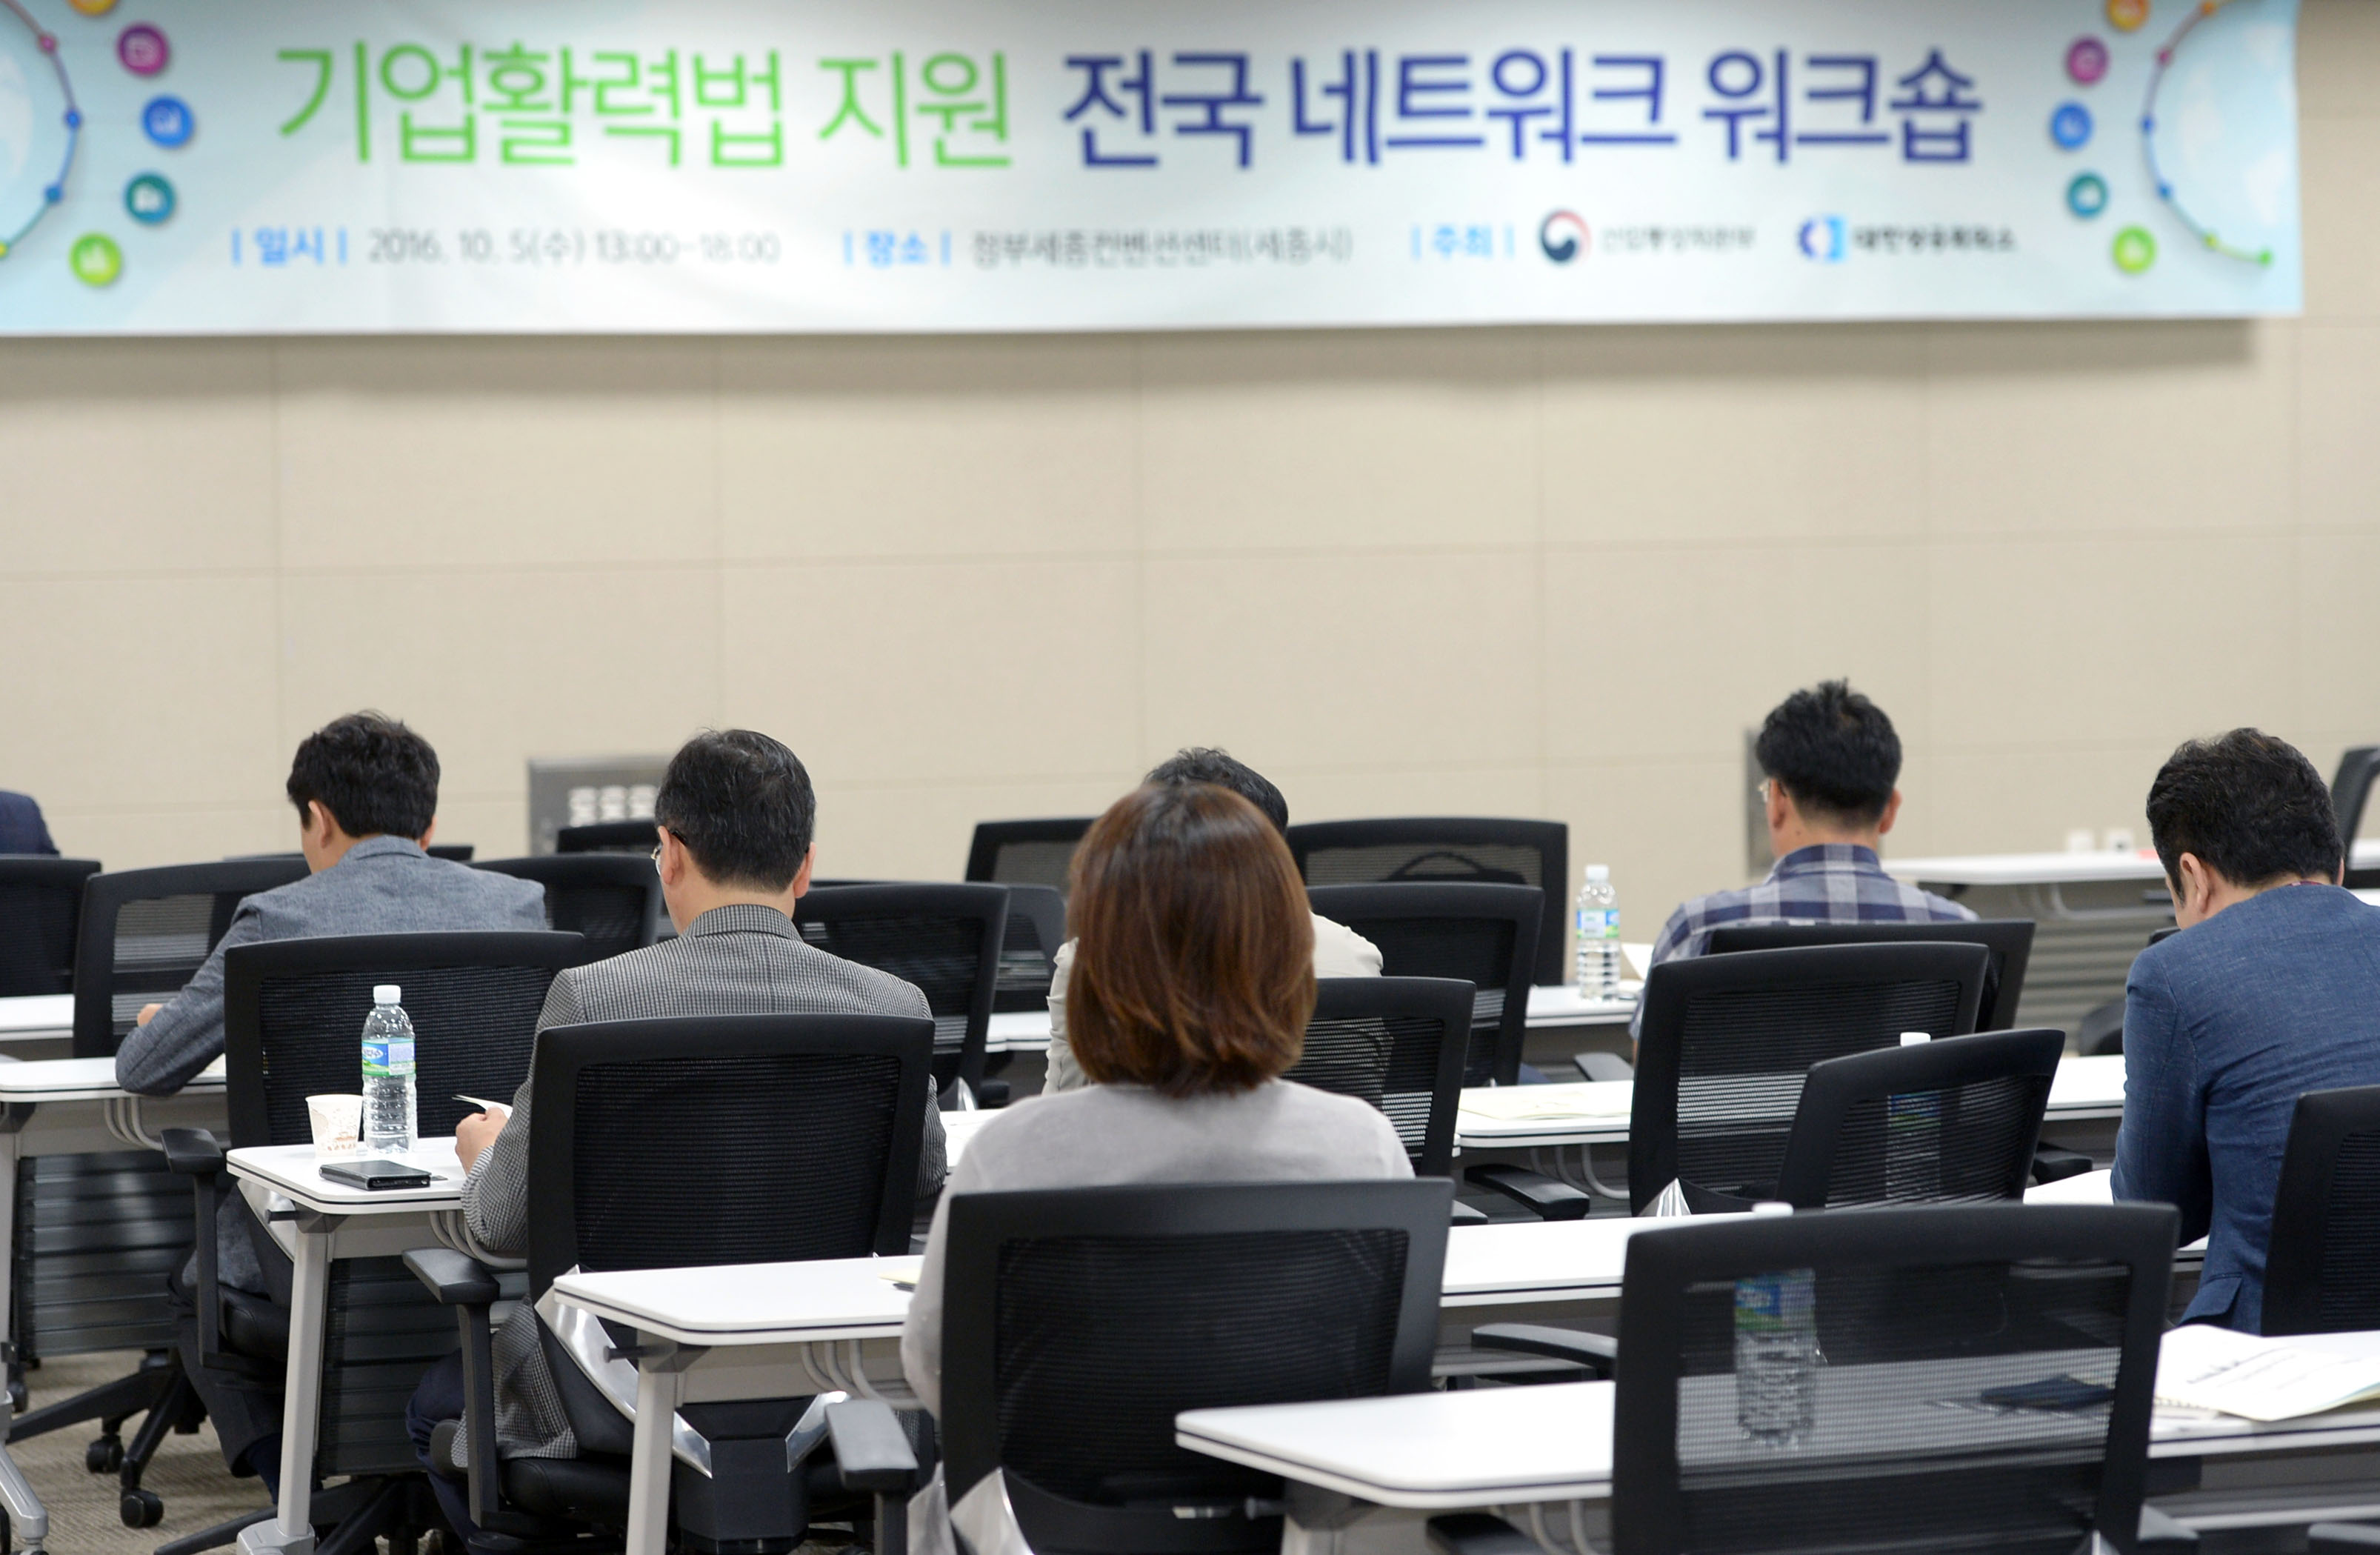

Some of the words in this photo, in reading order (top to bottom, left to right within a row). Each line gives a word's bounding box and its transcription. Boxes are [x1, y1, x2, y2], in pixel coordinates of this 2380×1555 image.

[278, 41, 784, 168] 기업활력법
[818, 50, 1011, 169] 지원
[1062, 49, 1264, 169] 전국
[1290, 48, 1679, 167] 네트워크
[1701, 48, 1984, 164] 워크숍
[253, 227, 324, 267] 일시
[864, 230, 927, 266] 장소
